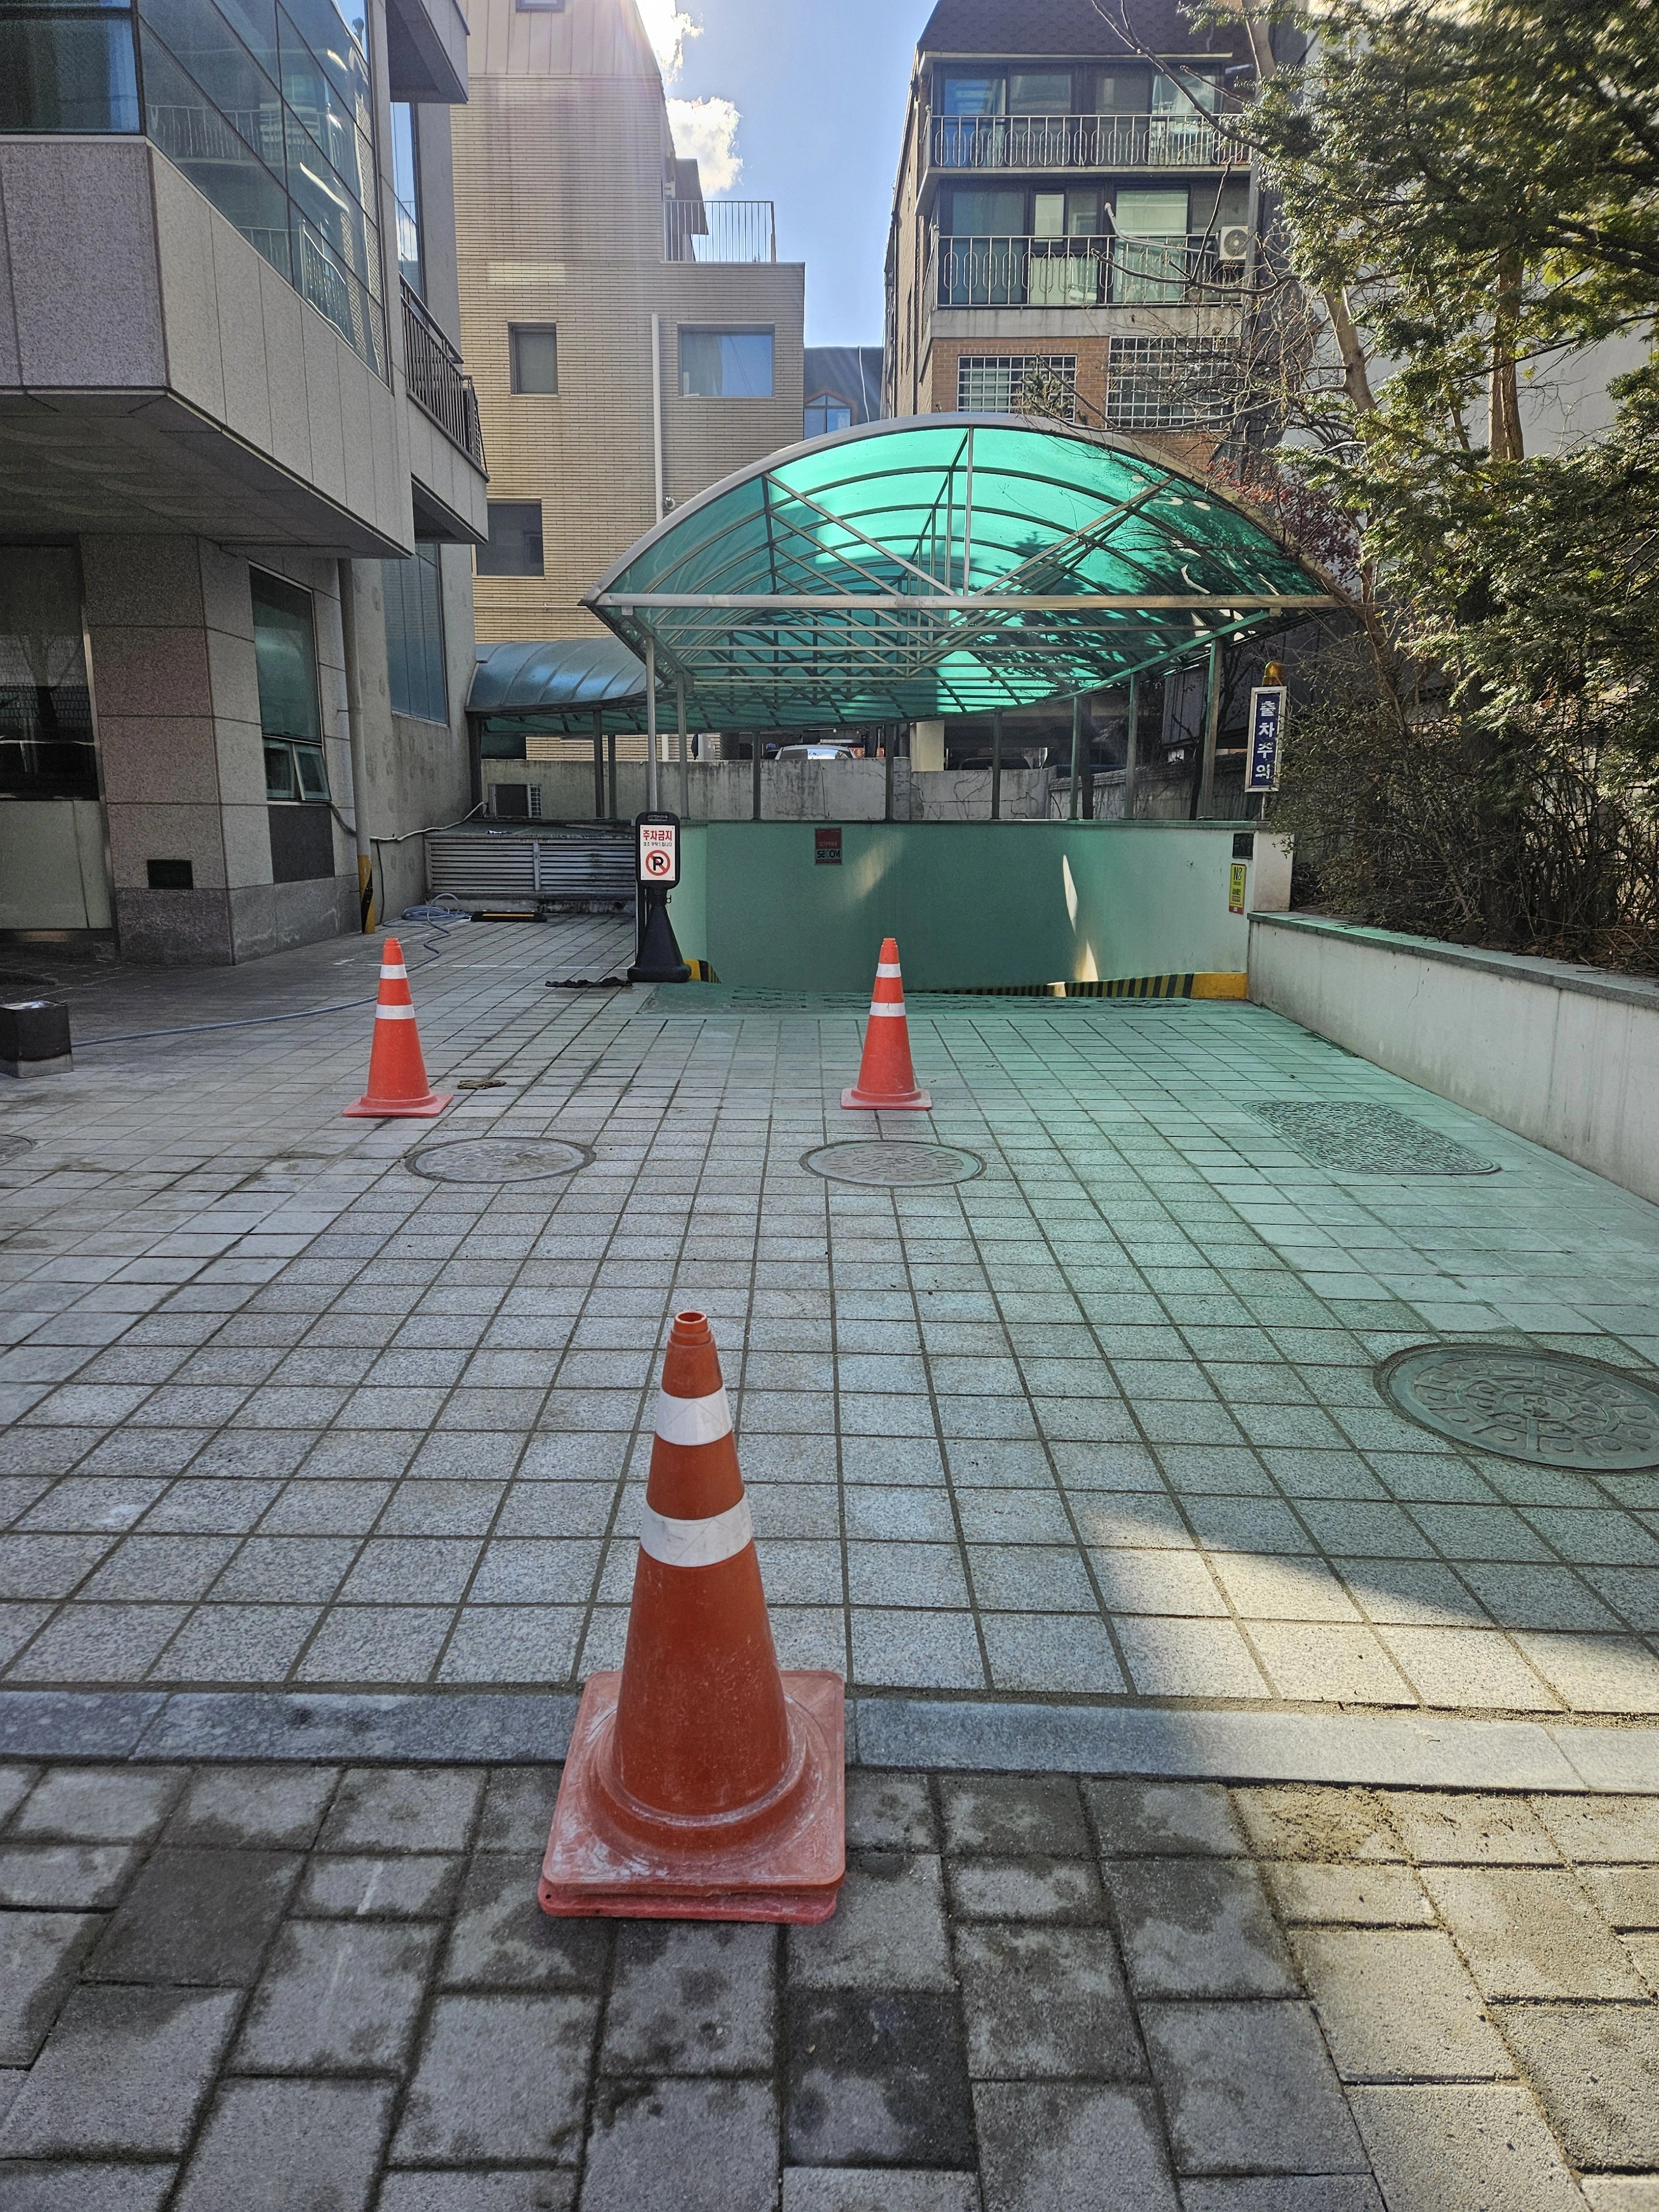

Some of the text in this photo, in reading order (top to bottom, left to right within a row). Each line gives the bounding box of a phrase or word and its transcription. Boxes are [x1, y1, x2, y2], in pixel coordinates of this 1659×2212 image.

[1255, 701, 1276, 779] 출차주의
[643, 830, 672, 841] 주차금지
[817, 849, 841, 858] SECOM
[653, 857, 664, 871] P
